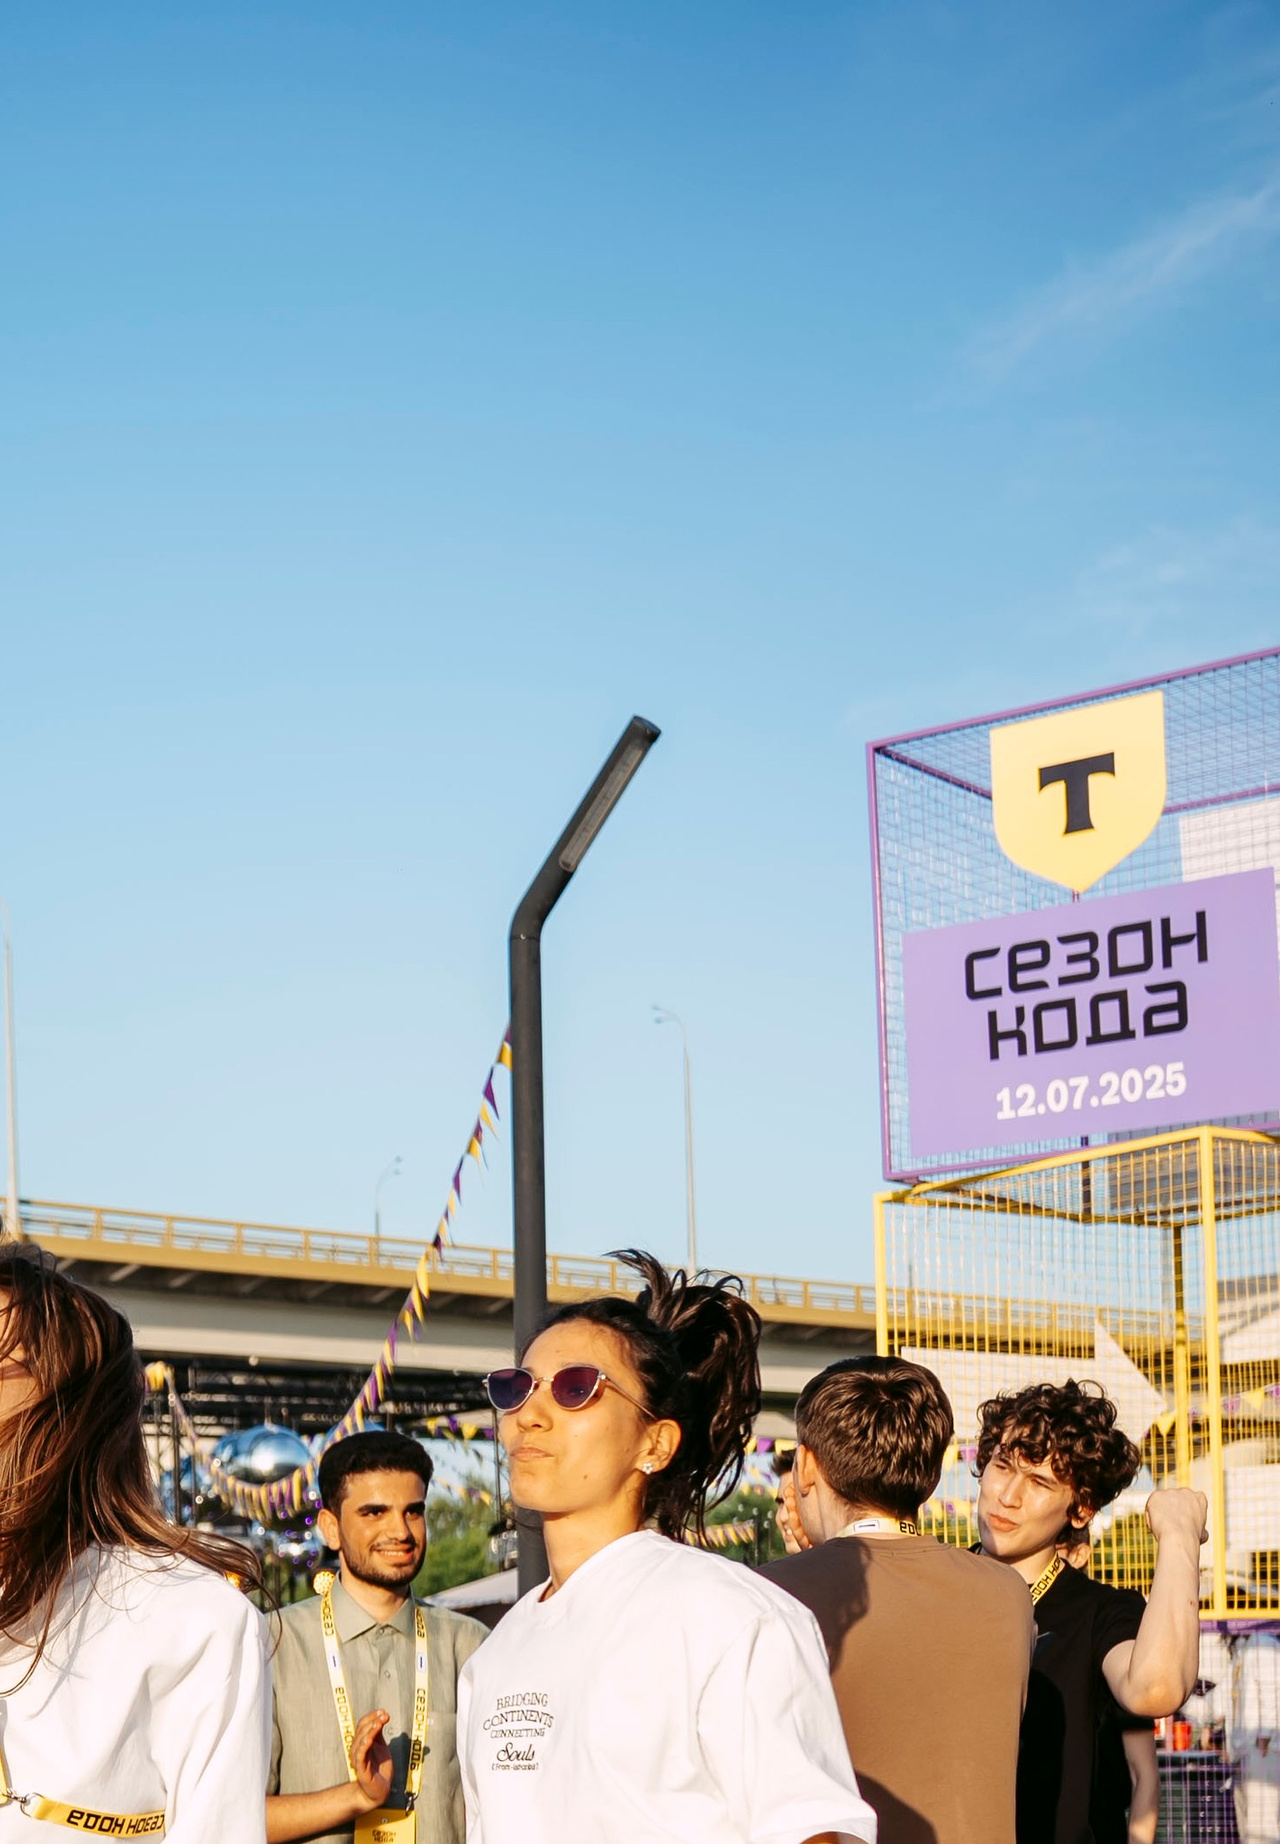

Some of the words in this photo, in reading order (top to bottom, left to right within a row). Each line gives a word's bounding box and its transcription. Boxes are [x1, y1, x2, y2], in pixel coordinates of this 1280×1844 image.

[996, 1061, 1188, 1120] 12.07.2025
[496, 1692, 549, 1711] BRIDGING
[483, 1709, 554, 1731] CONTINENTS
[496, 1742, 536, 1762] Souls
